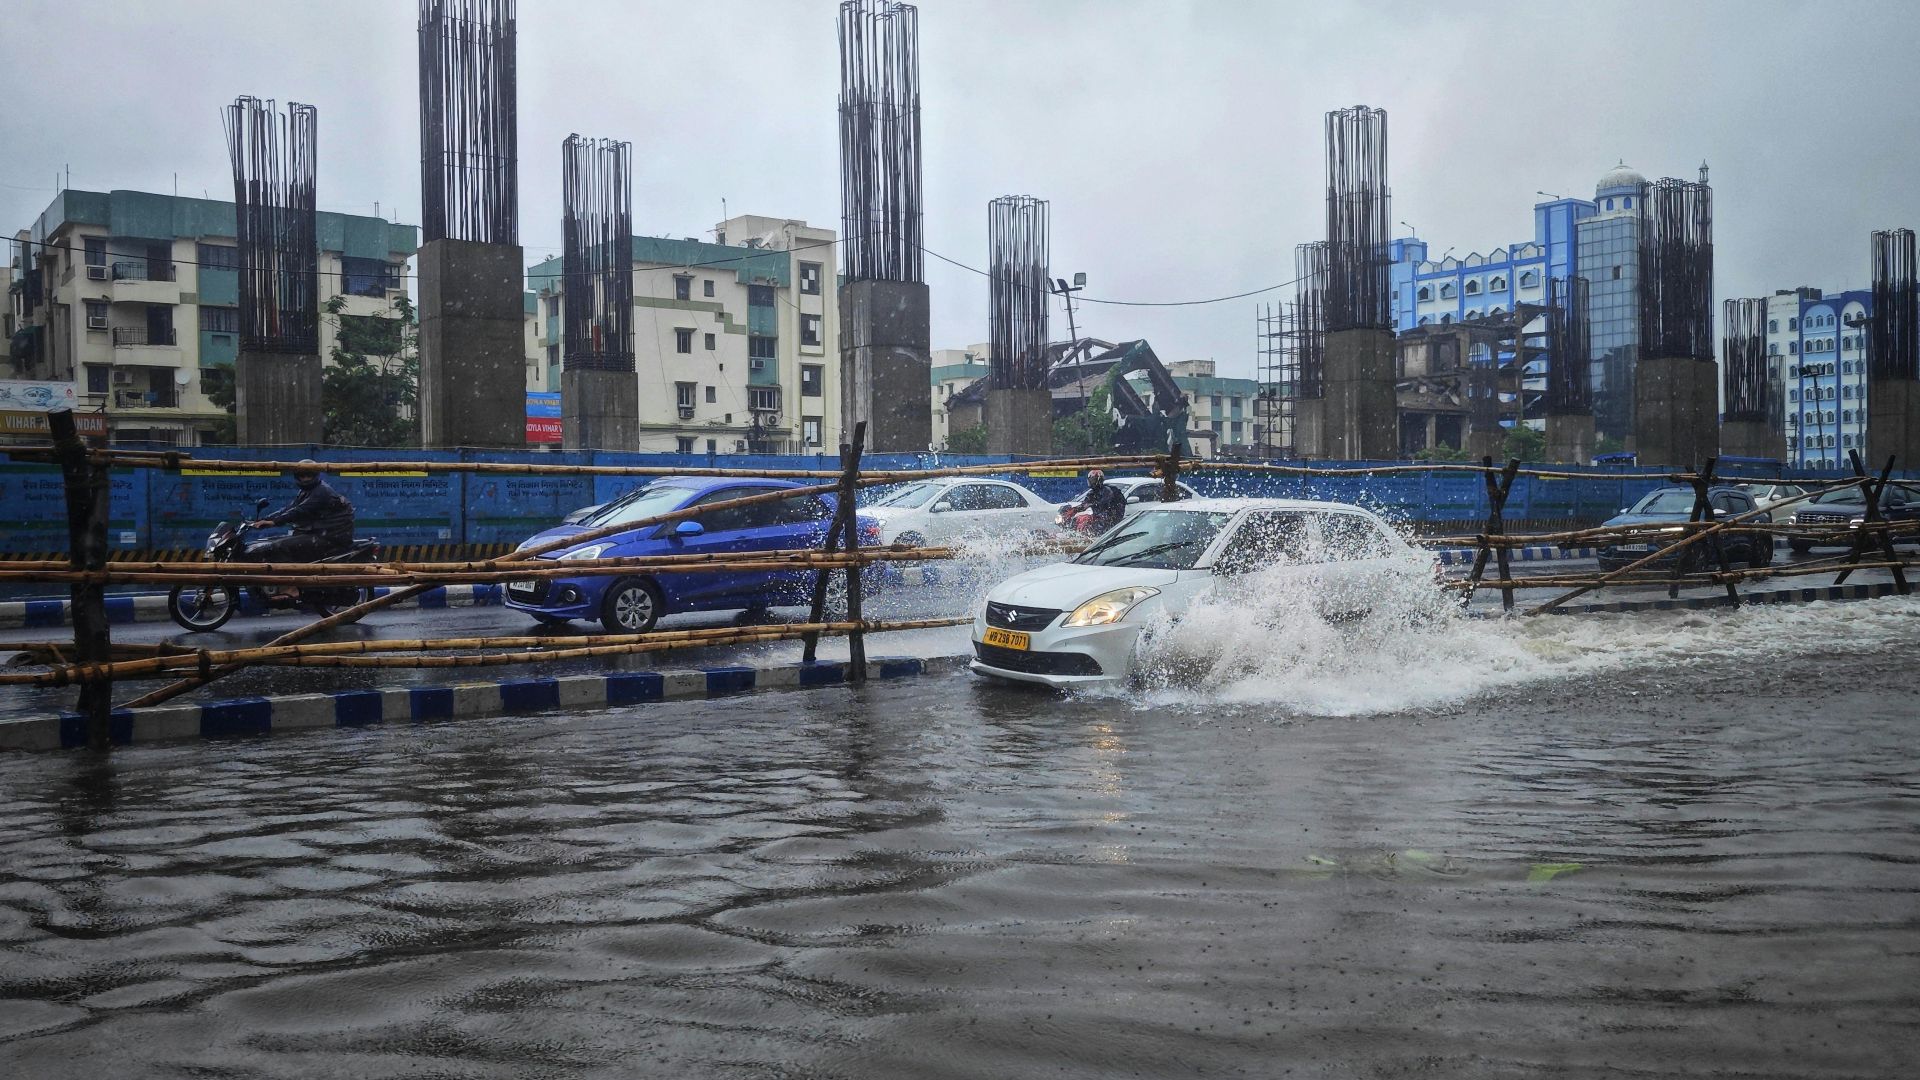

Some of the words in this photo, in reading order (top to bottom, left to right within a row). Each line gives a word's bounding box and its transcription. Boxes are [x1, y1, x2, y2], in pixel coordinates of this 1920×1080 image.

[5, 415, 37, 429] VIHAR
[542, 424, 559, 432] VIHAR
[989, 631, 998, 642] WB
[1011, 634, 1026, 647] 7071
